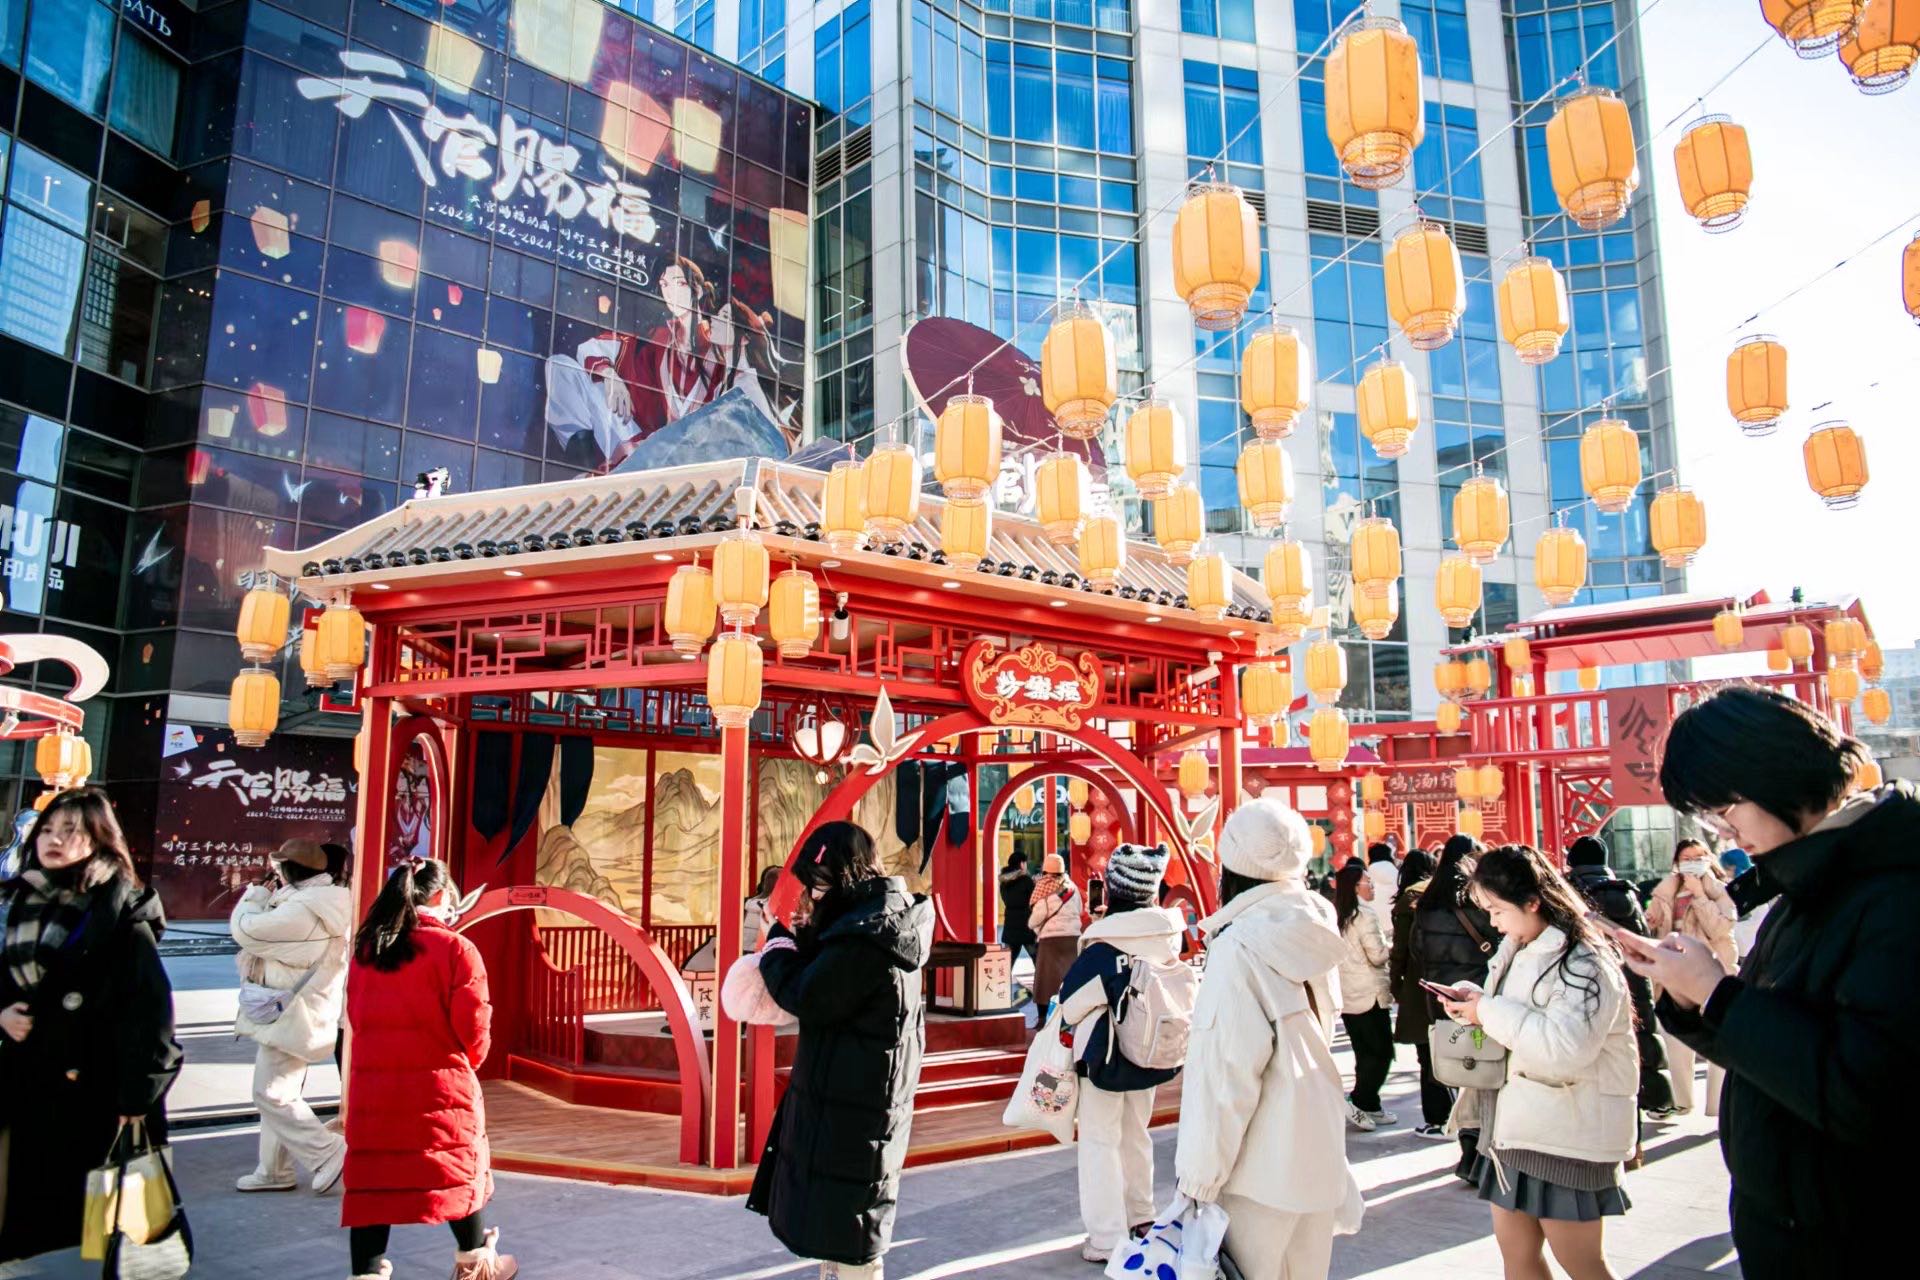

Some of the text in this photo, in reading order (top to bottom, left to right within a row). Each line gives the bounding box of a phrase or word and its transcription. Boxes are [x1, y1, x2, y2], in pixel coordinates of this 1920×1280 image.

[296, 50, 657, 243] 天官赐福
[191, 759, 346, 806] 天官赐福
